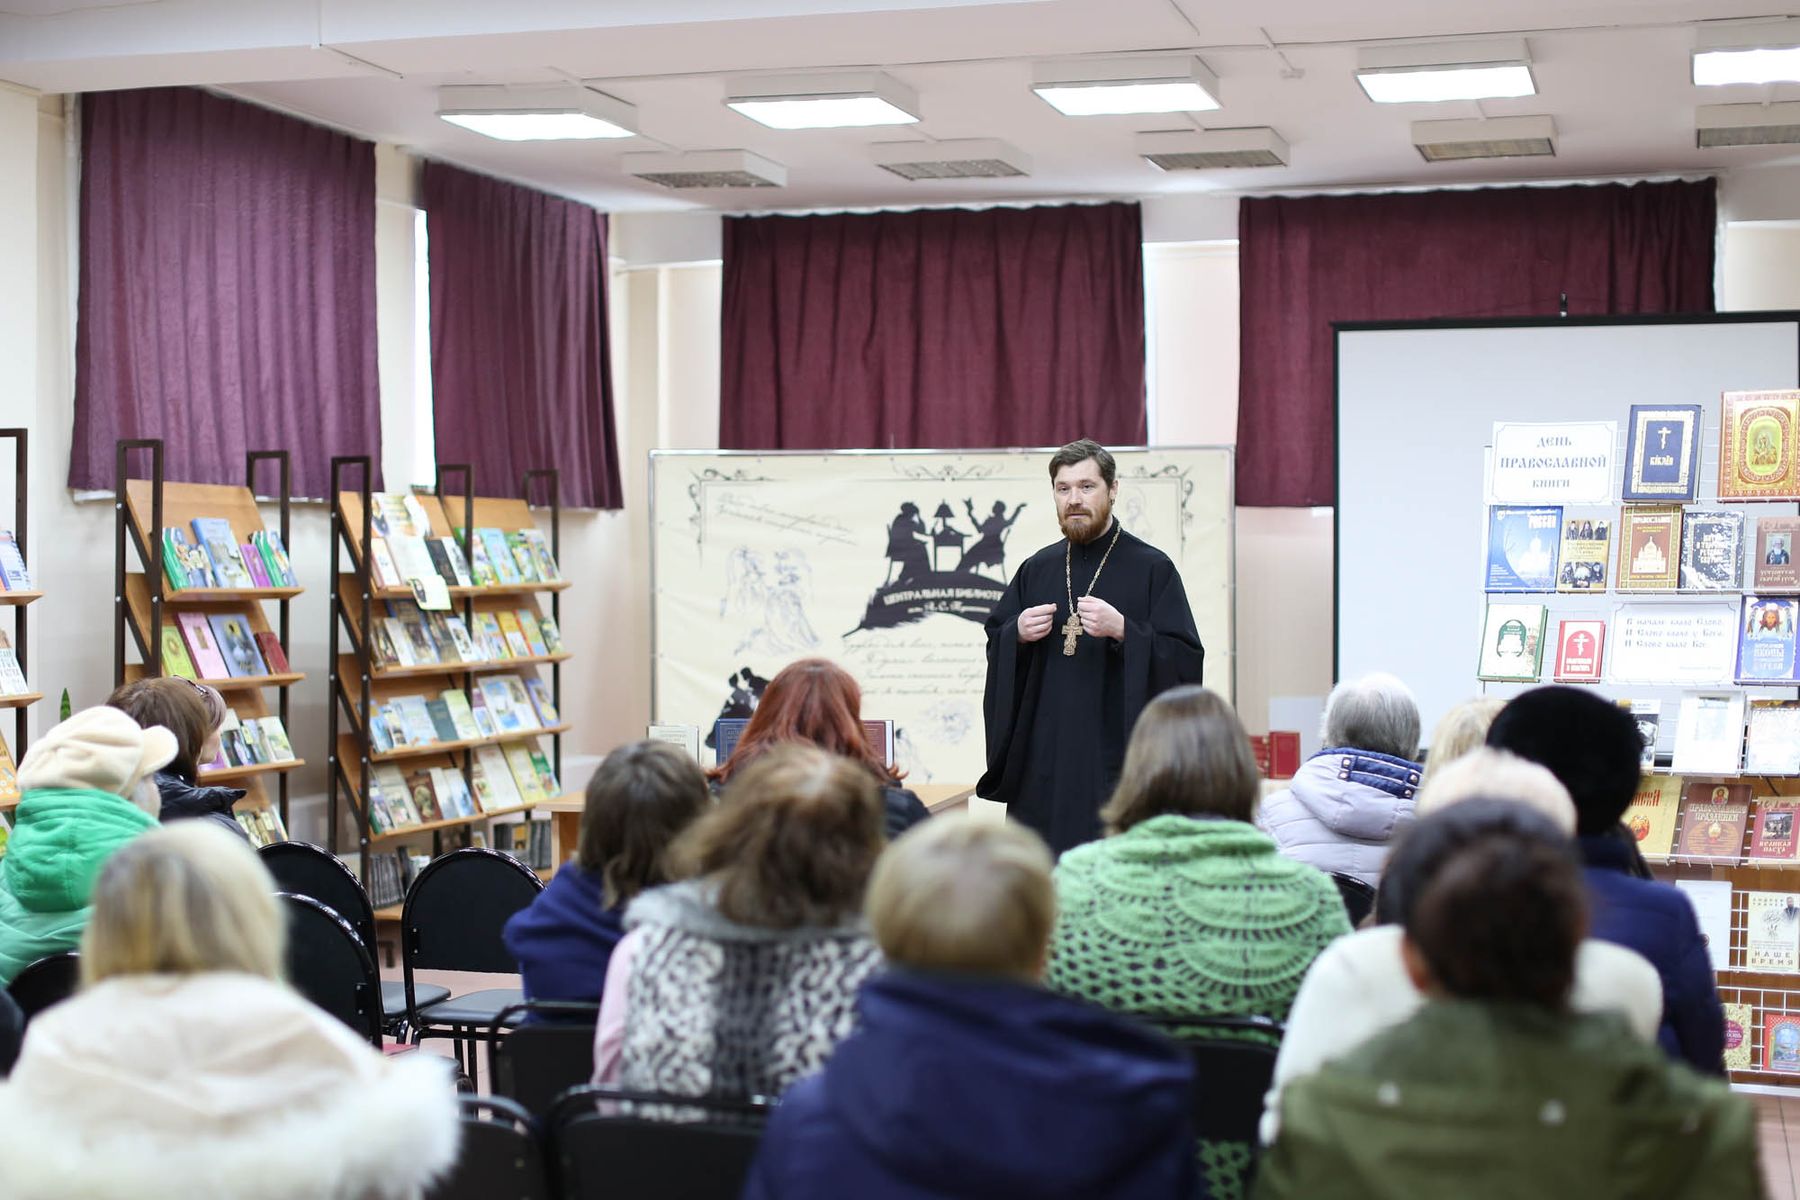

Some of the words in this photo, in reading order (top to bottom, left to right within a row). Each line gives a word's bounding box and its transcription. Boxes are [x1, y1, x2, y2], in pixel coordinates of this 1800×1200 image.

[1536, 436, 1573, 448] ДЕНЬ
[1500, 454, 1607, 469] ПРАВОСЛАВНОЙ
[1531, 478, 1571, 489] КНИГИ
